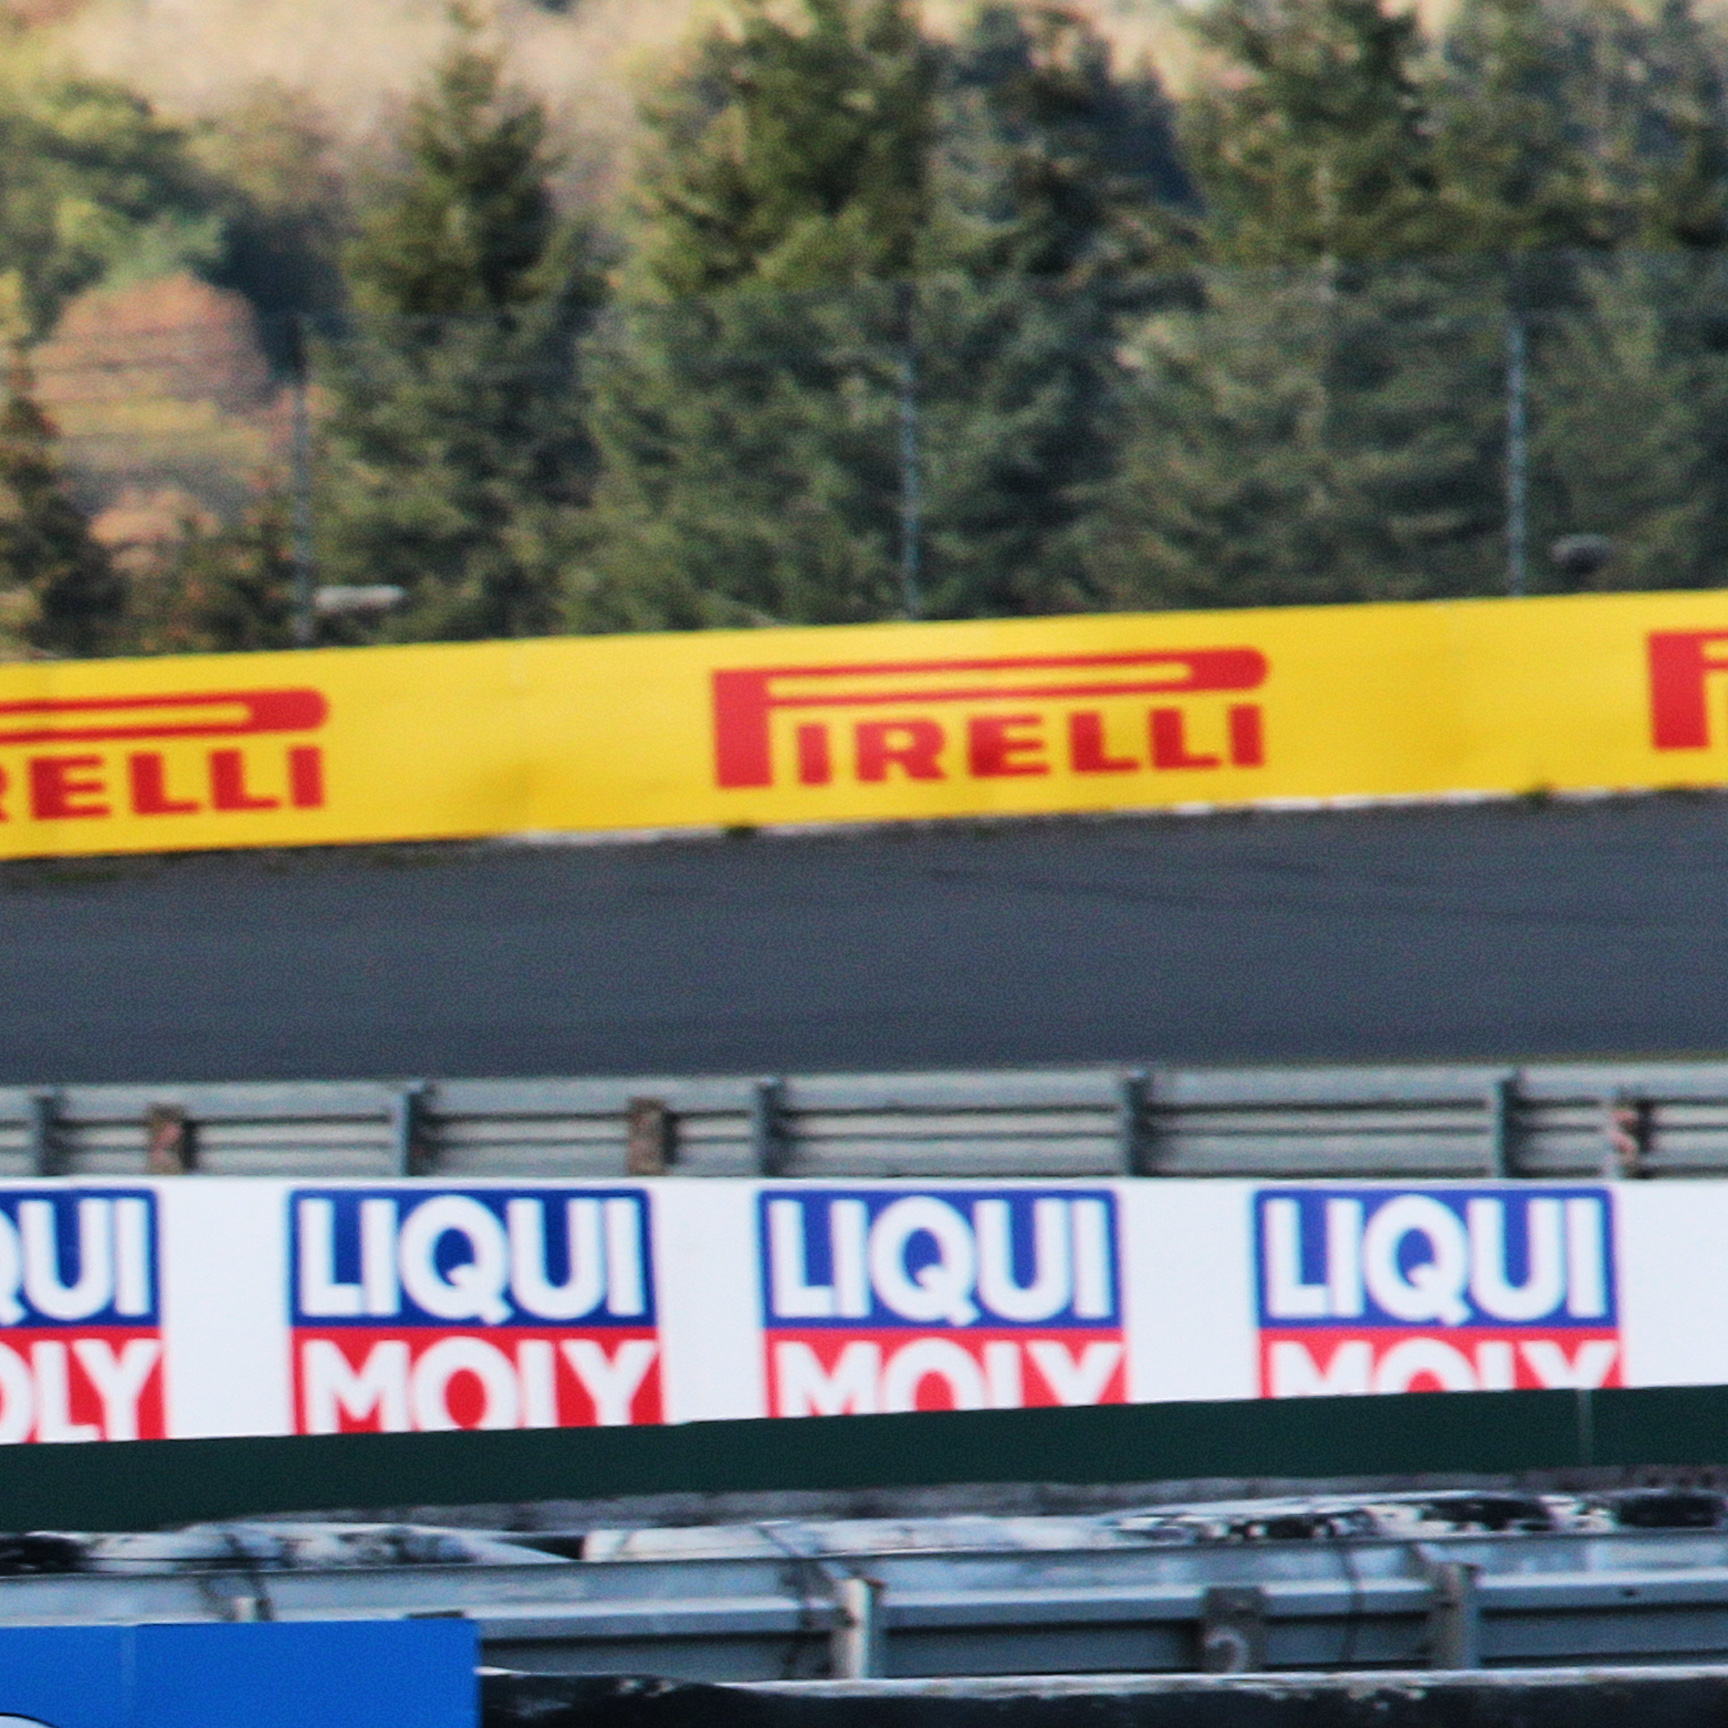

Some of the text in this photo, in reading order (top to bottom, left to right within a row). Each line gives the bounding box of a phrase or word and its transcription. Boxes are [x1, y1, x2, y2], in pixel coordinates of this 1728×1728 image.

[712, 646, 1269, 789] PIRELLI
[300, 1196, 651, 1327] LIQUI
[769, 1196, 1115, 1328] LIQUI
[1265, 1196, 1611, 1327] LIQUI
